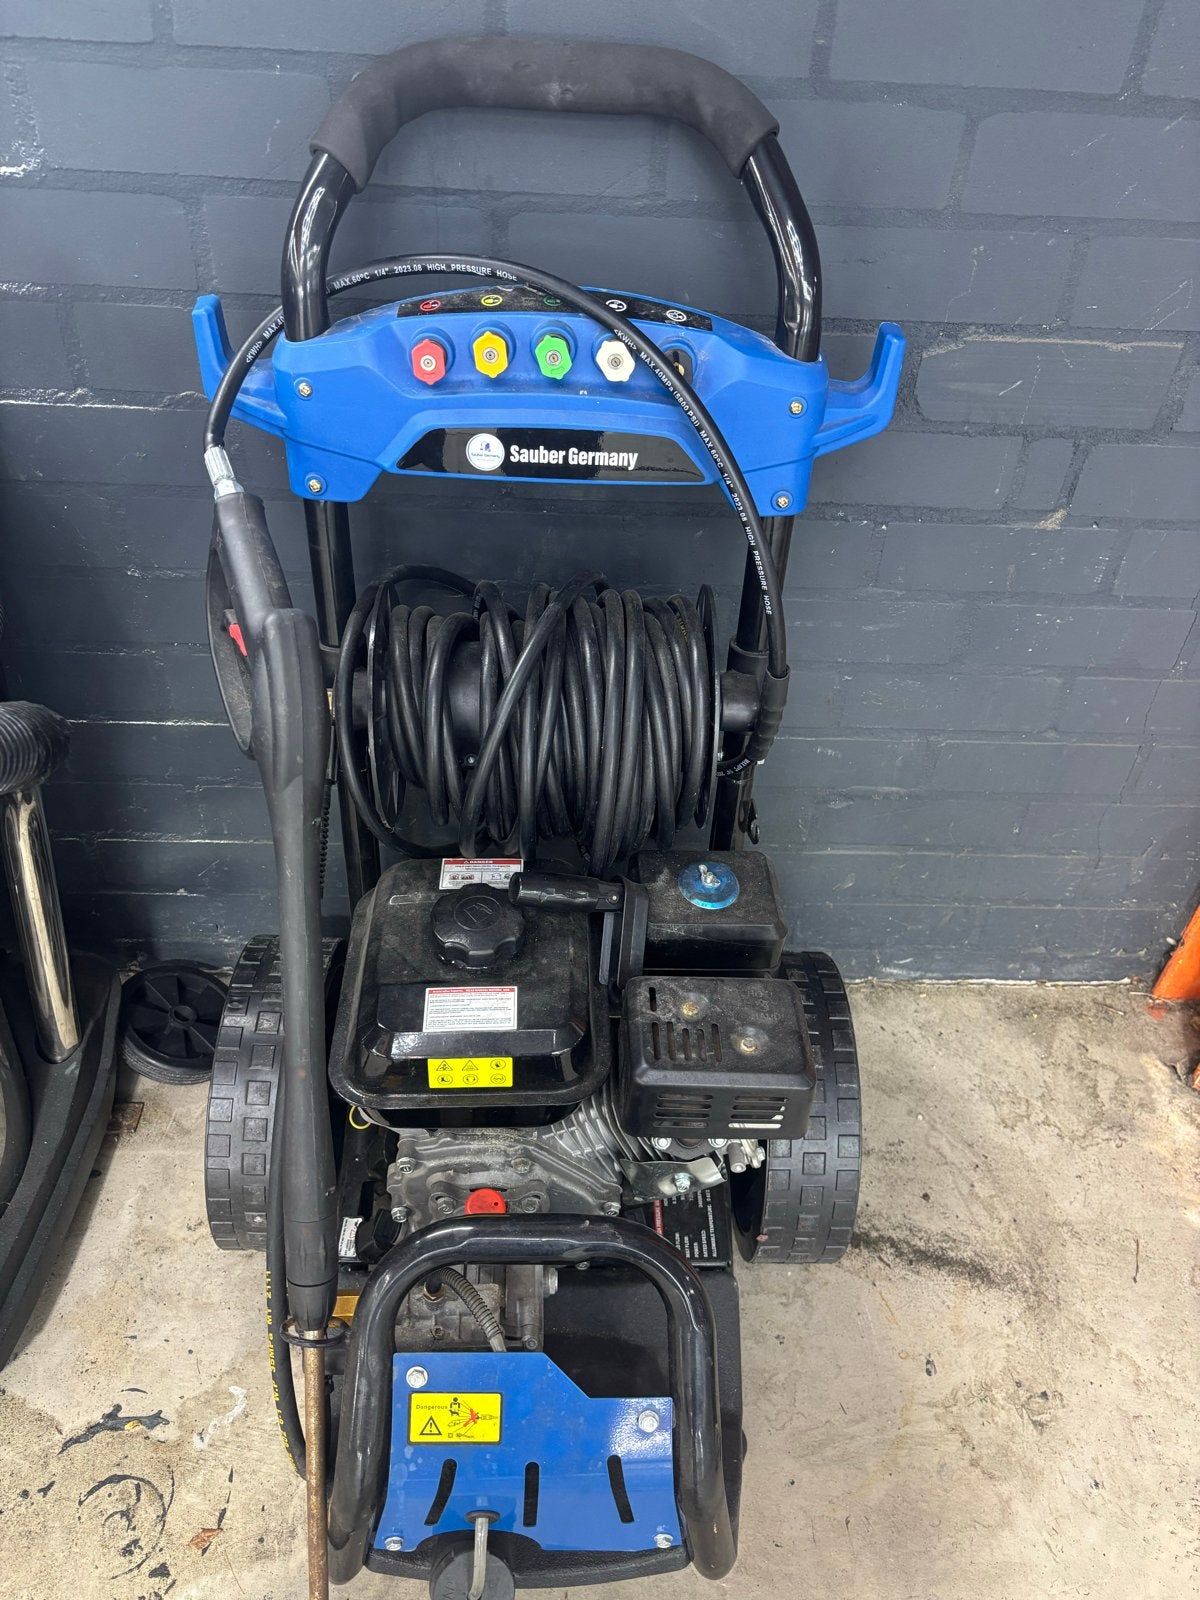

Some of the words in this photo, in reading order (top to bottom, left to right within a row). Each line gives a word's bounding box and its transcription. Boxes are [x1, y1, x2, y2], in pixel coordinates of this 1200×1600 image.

[374, 267, 389, 277] 1/4"
[393, 263, 423, 275] 2023.08
[426, 263, 447, 272] HIGH
[450, 263, 492, 276] PRESSURE
[496, 269, 518, 282] HOSE
[246, 340, 263, 363] <KWH>
[509, 444, 566, 465] Sauber
[568, 447, 639, 471] Germany
[613, 328, 637, 351] <KWH>
[640, 351, 674, 393] MAX.40MPa
[673, 391, 690, 412] (5800
[687, 410, 700, 428] PSI)
[732, 493, 748, 522] 2023.08
[745, 526, 756, 546] HIGH
[753, 550, 768, 591] PRESSURE
[763, 595, 772, 615] HOSE
